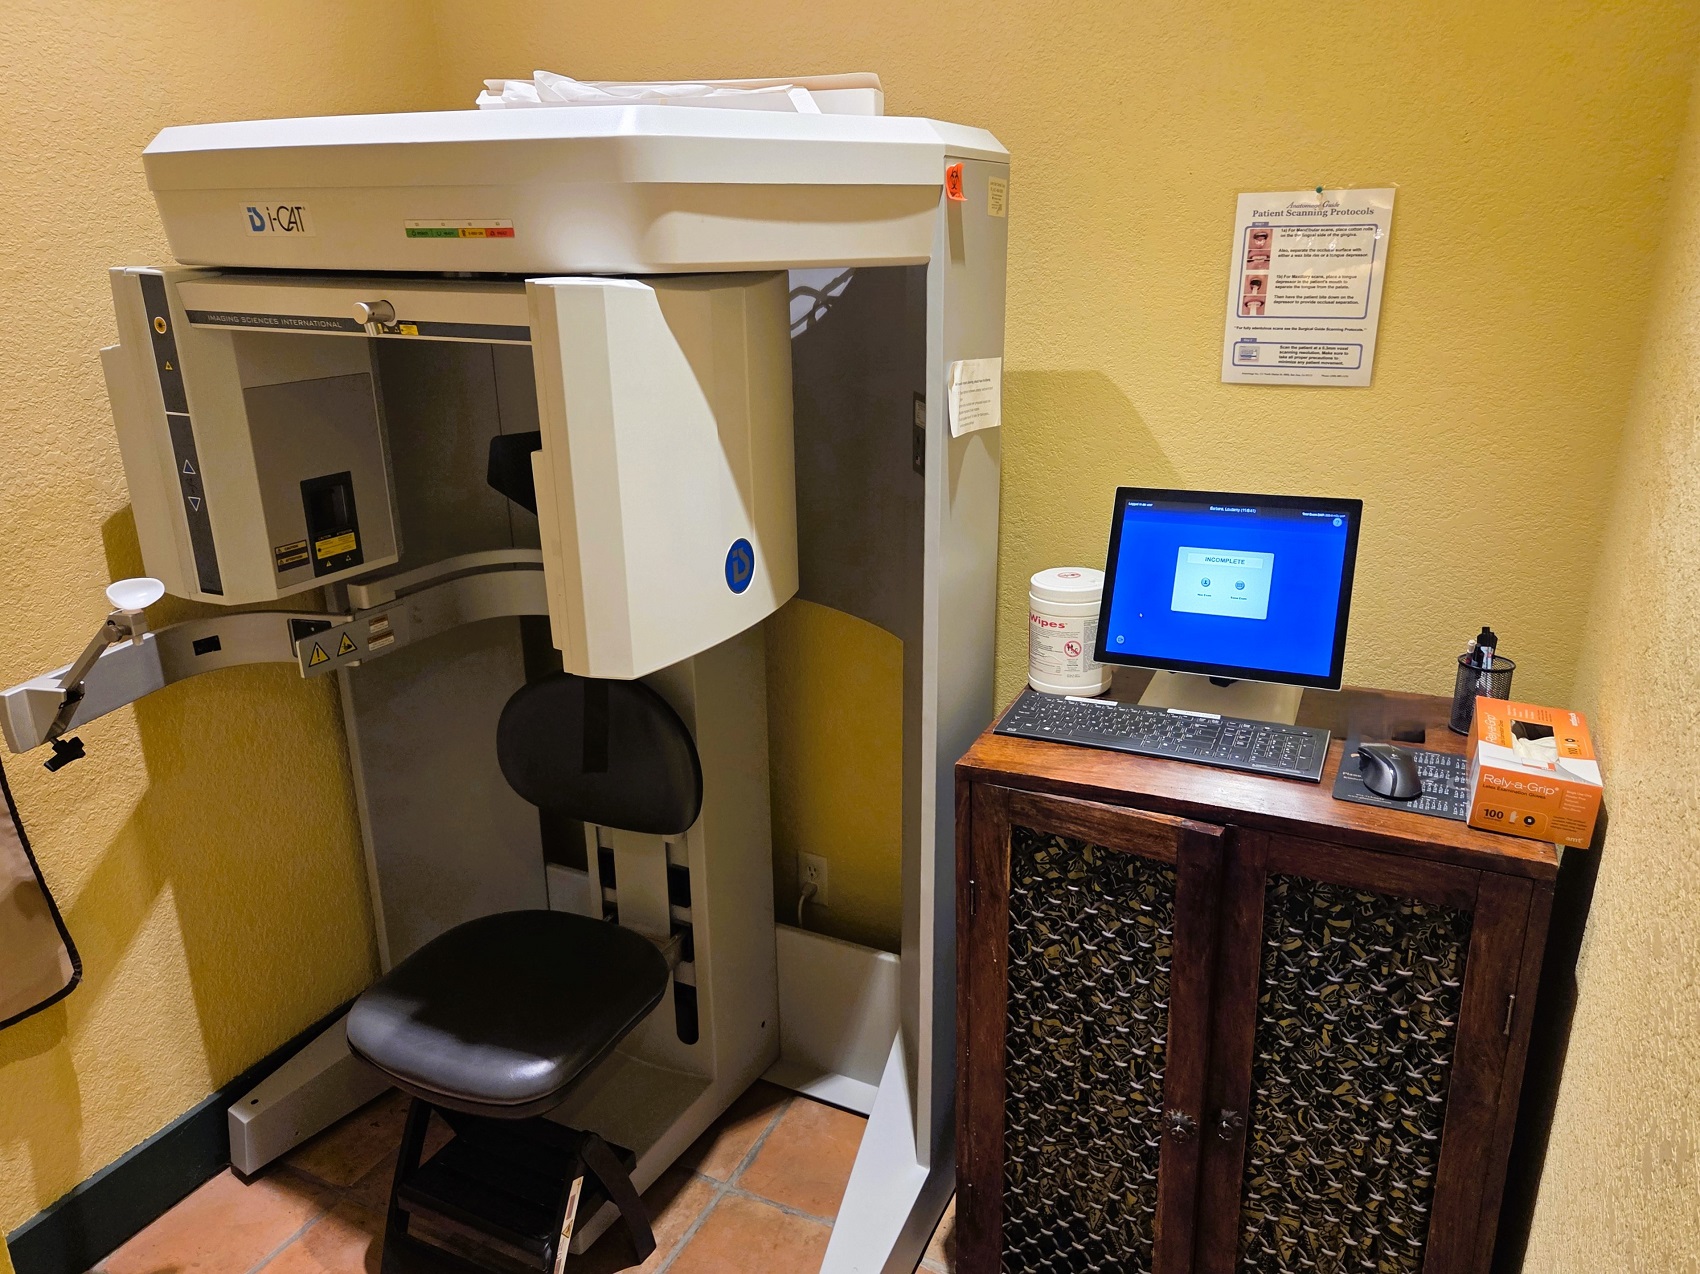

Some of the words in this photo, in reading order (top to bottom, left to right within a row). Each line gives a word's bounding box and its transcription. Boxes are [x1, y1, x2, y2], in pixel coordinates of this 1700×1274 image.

[1286, 209, 1328, 217] Scanning
[1330, 207, 1374, 216] Protocols
[266, 205, 304, 232] i-CAT
[281, 319, 342, 328] INTERNATIONAL
[1497, 786, 1527, 796] Examination
[1484, 809, 1504, 819] 100
